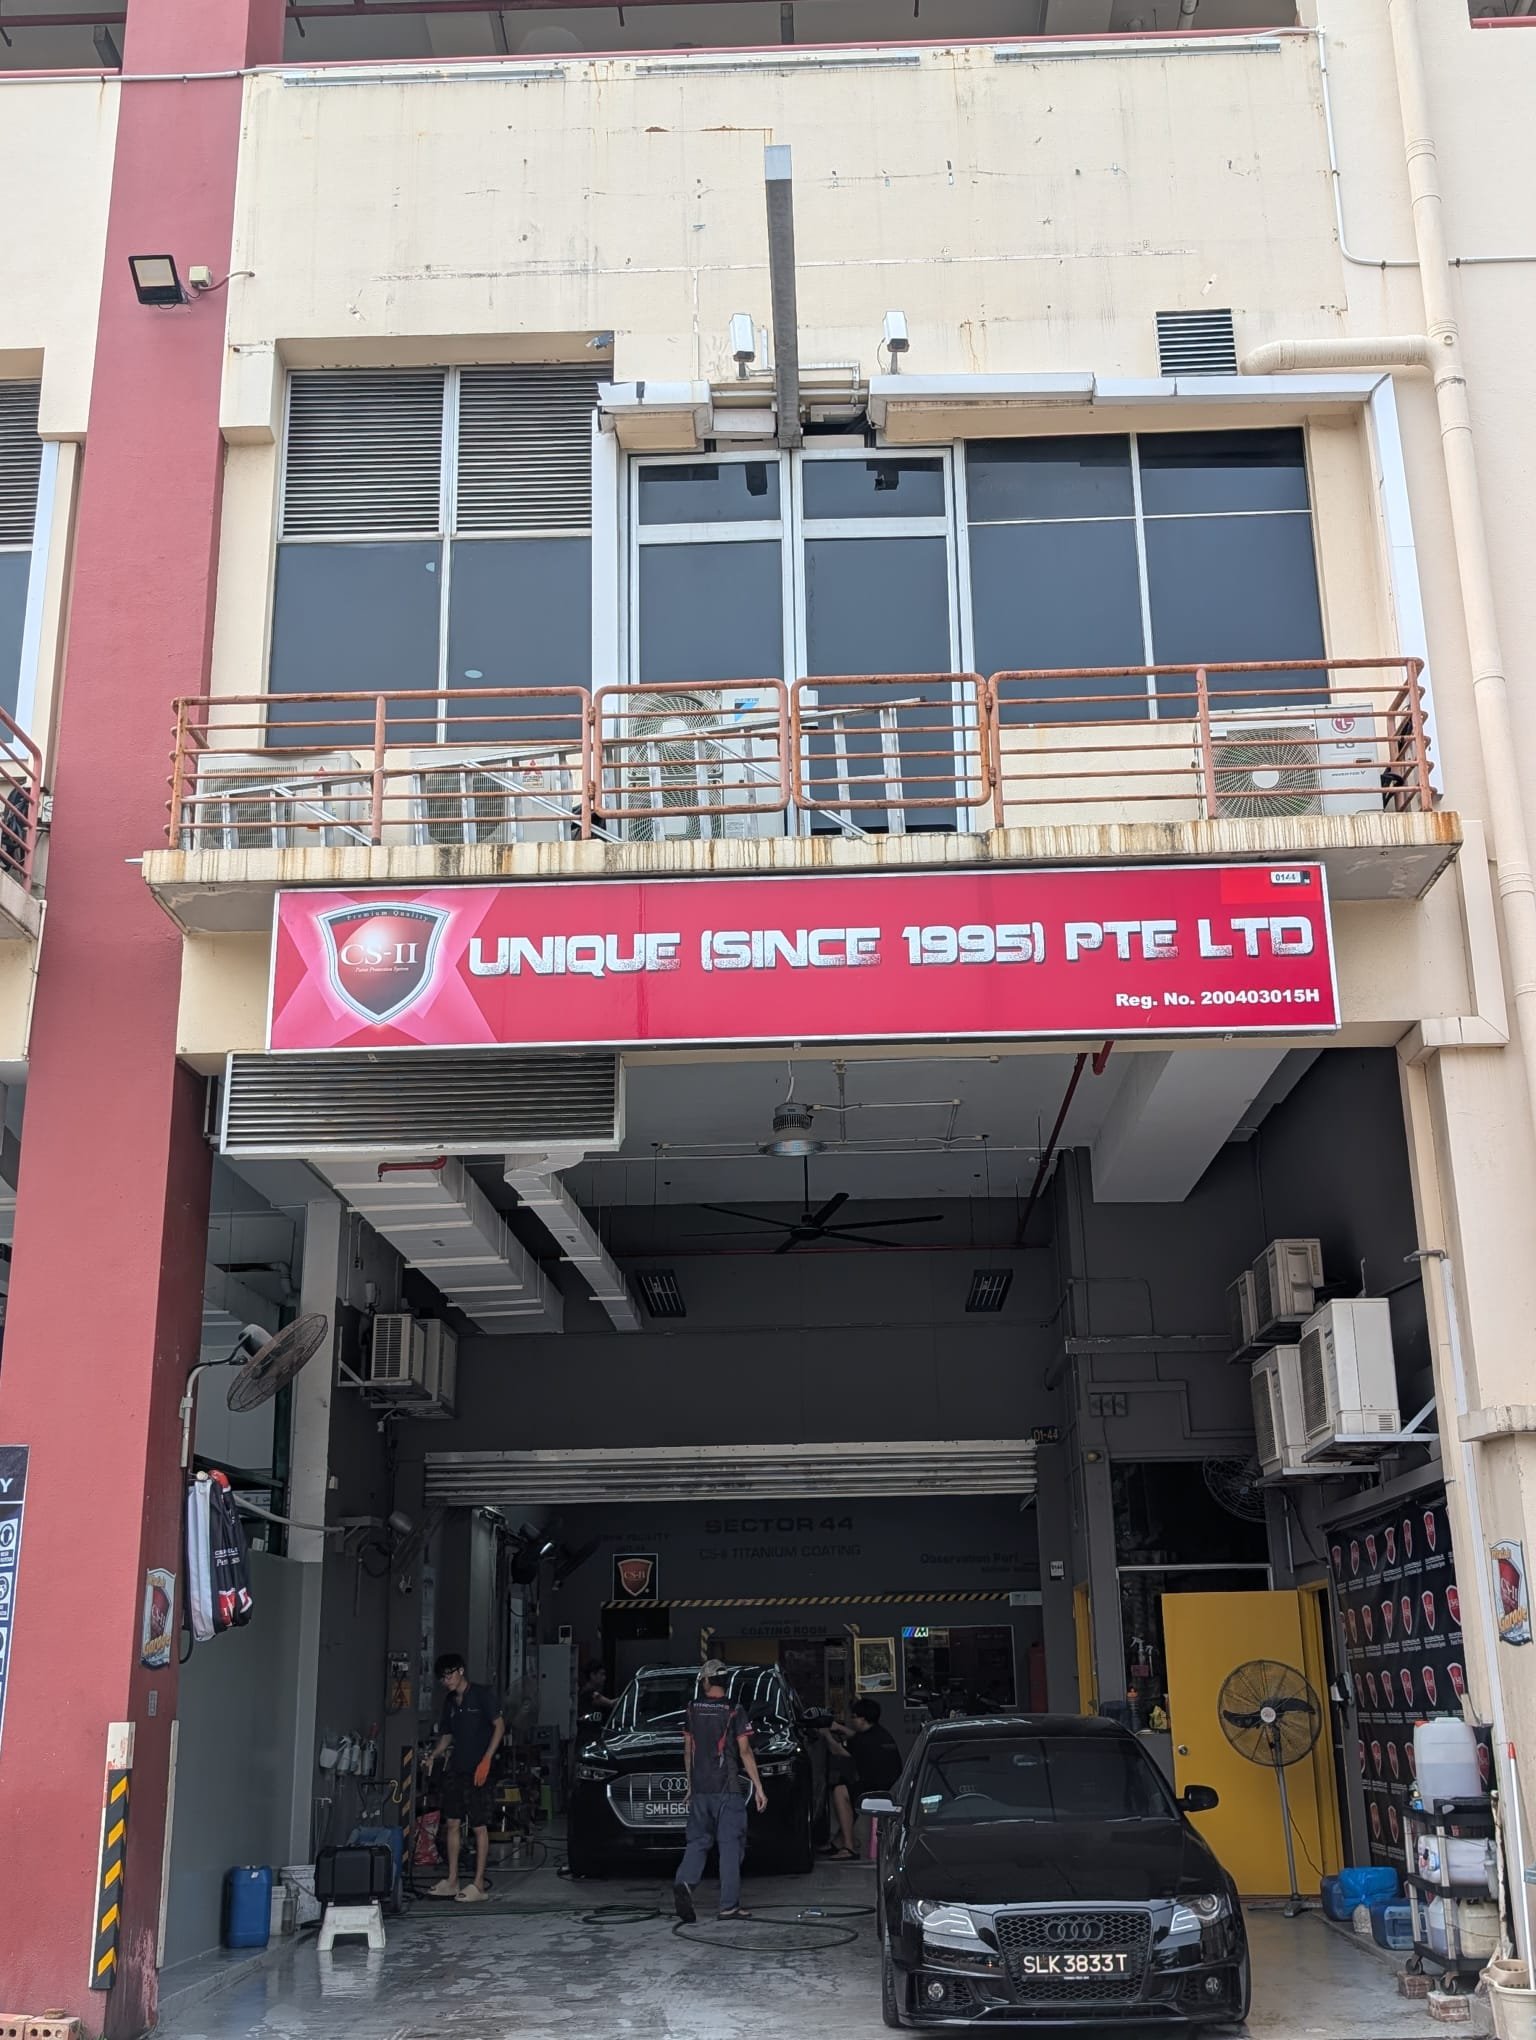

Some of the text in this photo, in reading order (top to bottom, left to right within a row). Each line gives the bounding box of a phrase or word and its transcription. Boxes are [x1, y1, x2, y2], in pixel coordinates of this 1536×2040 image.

[346, 909, 429, 922] Premium Quality
[341, 942, 419, 966] CS-II
[469, 915, 1315, 977] UNIQUE (SINCE 1995) PTE LTD
[1116, 988, 1320, 1009] Reg. No. 200403015H
[704, 1516, 853, 1534] SECTOR 44
